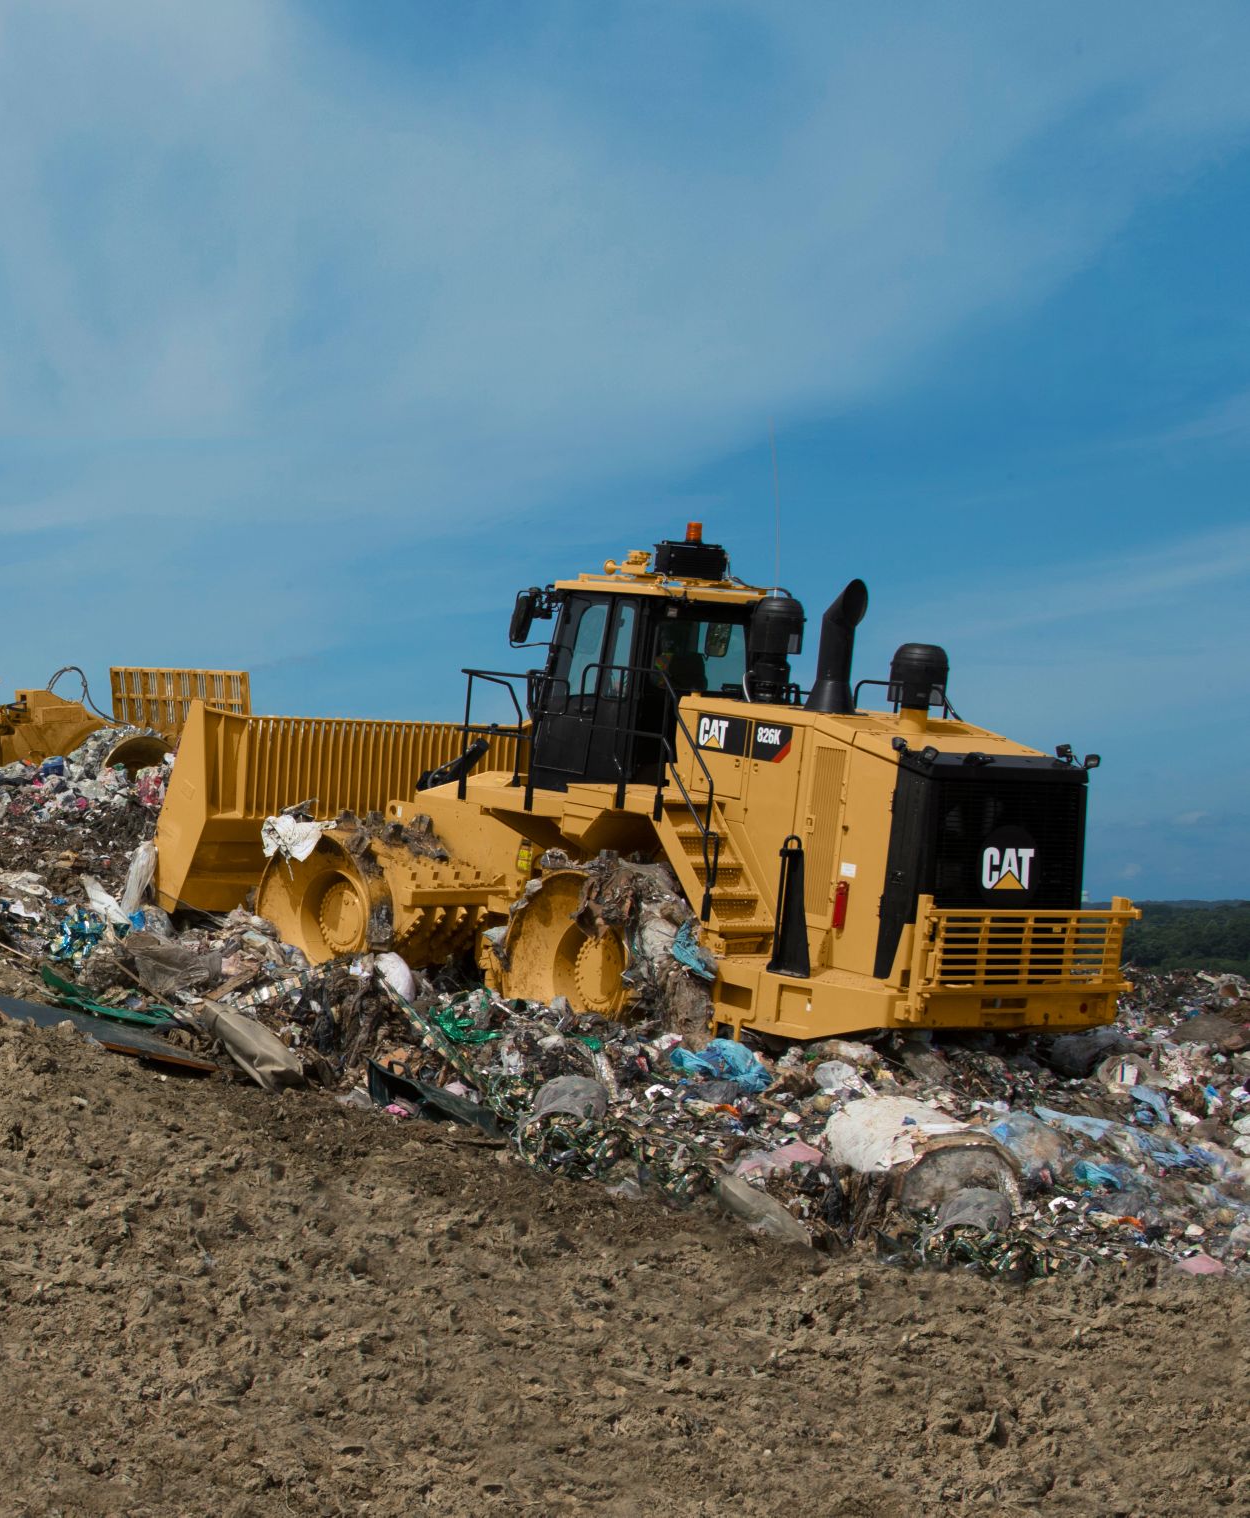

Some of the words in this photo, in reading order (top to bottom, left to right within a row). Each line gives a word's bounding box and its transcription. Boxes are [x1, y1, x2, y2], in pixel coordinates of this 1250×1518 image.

[698, 717, 730, 750] CAT
[756, 726, 782, 746] 826K
[981, 846, 1035, 890] CAT
